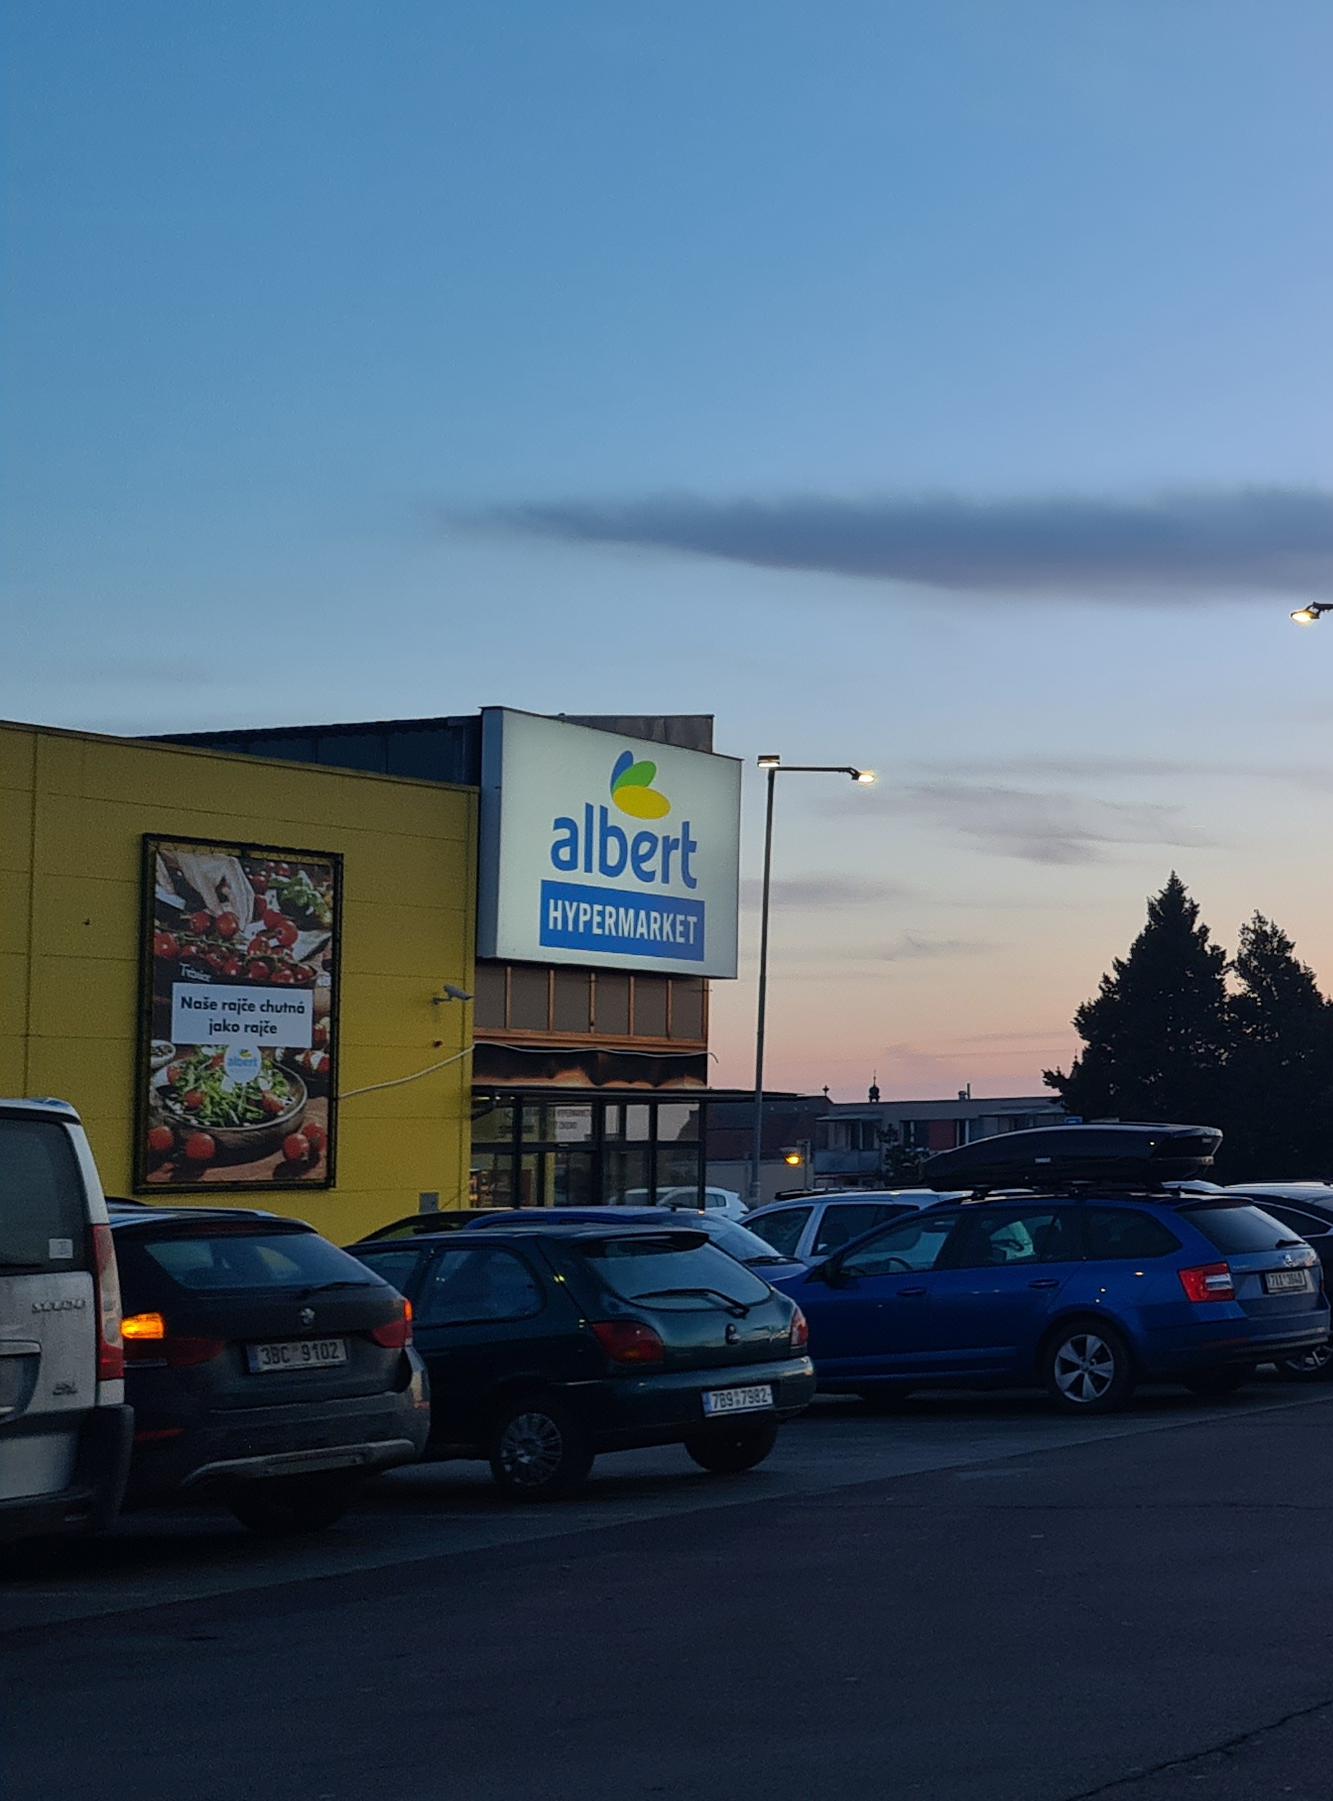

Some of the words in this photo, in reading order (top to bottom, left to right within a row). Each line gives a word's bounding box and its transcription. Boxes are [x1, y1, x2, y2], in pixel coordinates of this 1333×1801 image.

[551, 802, 697, 889] albert
[549, 899, 698, 944] HYPERMARKET
[181, 996, 218, 1011] Naše
[222, 997, 256, 1015] rajče
[260, 999, 305, 1014] chutná
[209, 1019, 240, 1035] jako
[244, 1020, 278, 1037] rajče
[302, 1342, 340, 1361] 9102
